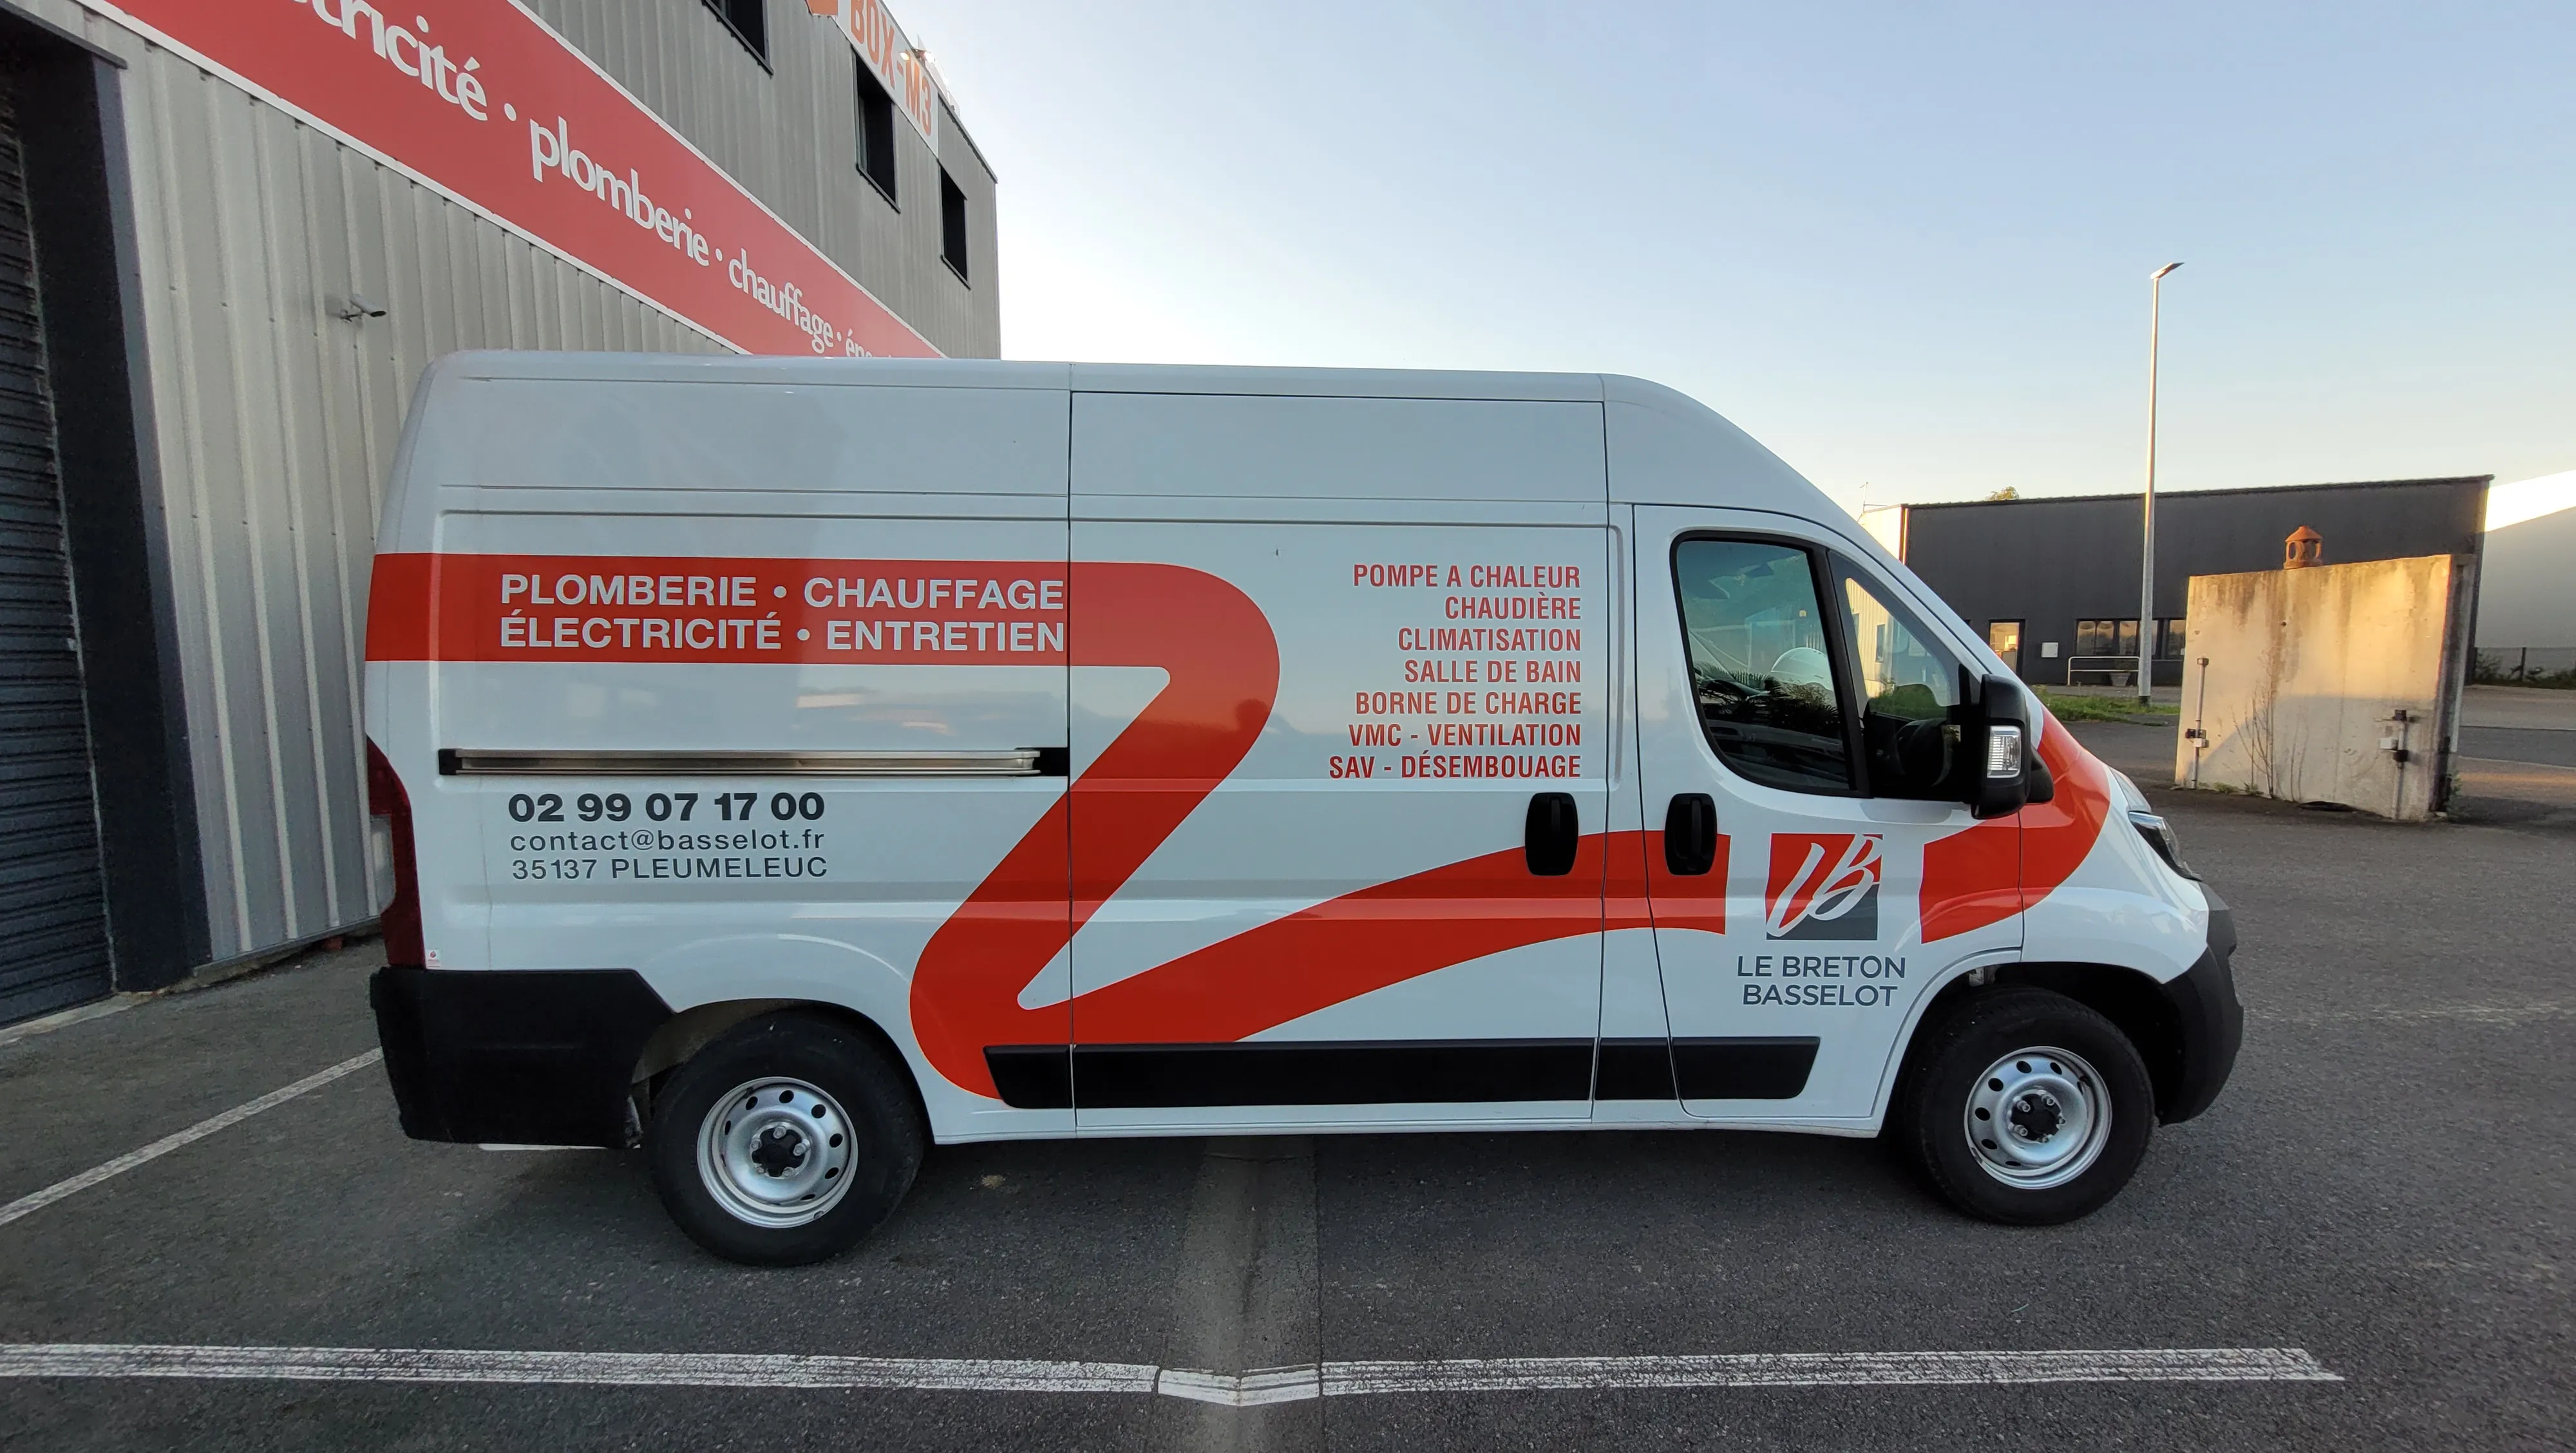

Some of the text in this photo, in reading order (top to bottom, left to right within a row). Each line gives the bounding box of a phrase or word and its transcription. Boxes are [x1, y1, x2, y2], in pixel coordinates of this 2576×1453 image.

[529, 115, 710, 266] plomberie
[728, 248, 834, 354] chauffage
[1354, 564, 1580, 589] POMPE A CHALEUR
[501, 574, 1065, 610] PLOMBERIE CHAUFFAGE
[1445, 591, 1581, 620] CHAUDIÈRE
[500, 609, 1065, 652] ÉLECTRICITÉ ENTRETIEN
[1399, 627, 1581, 651] CLIMATISATION
[1405, 660, 1581, 683] SALLE DE BAIN
[1356, 691, 1581, 715] BORNE DE CHARGE
[1349, 723, 1402, 747] VMC
[1428, 723, 1581, 746] VENTILATION
[1329, 755, 1376, 779] SAV
[1401, 749, 1581, 779] DÉSEMBOUAGE
[508, 792, 825, 822] 02 99 07 17 00
[510, 828, 825, 851] contact@basselot.fr
[512, 857, 828, 880] 35137 PLEUMELEUC
[1738, 955, 1906, 978] LE BRETON
[1743, 984, 1899, 1007] BASSELOT
